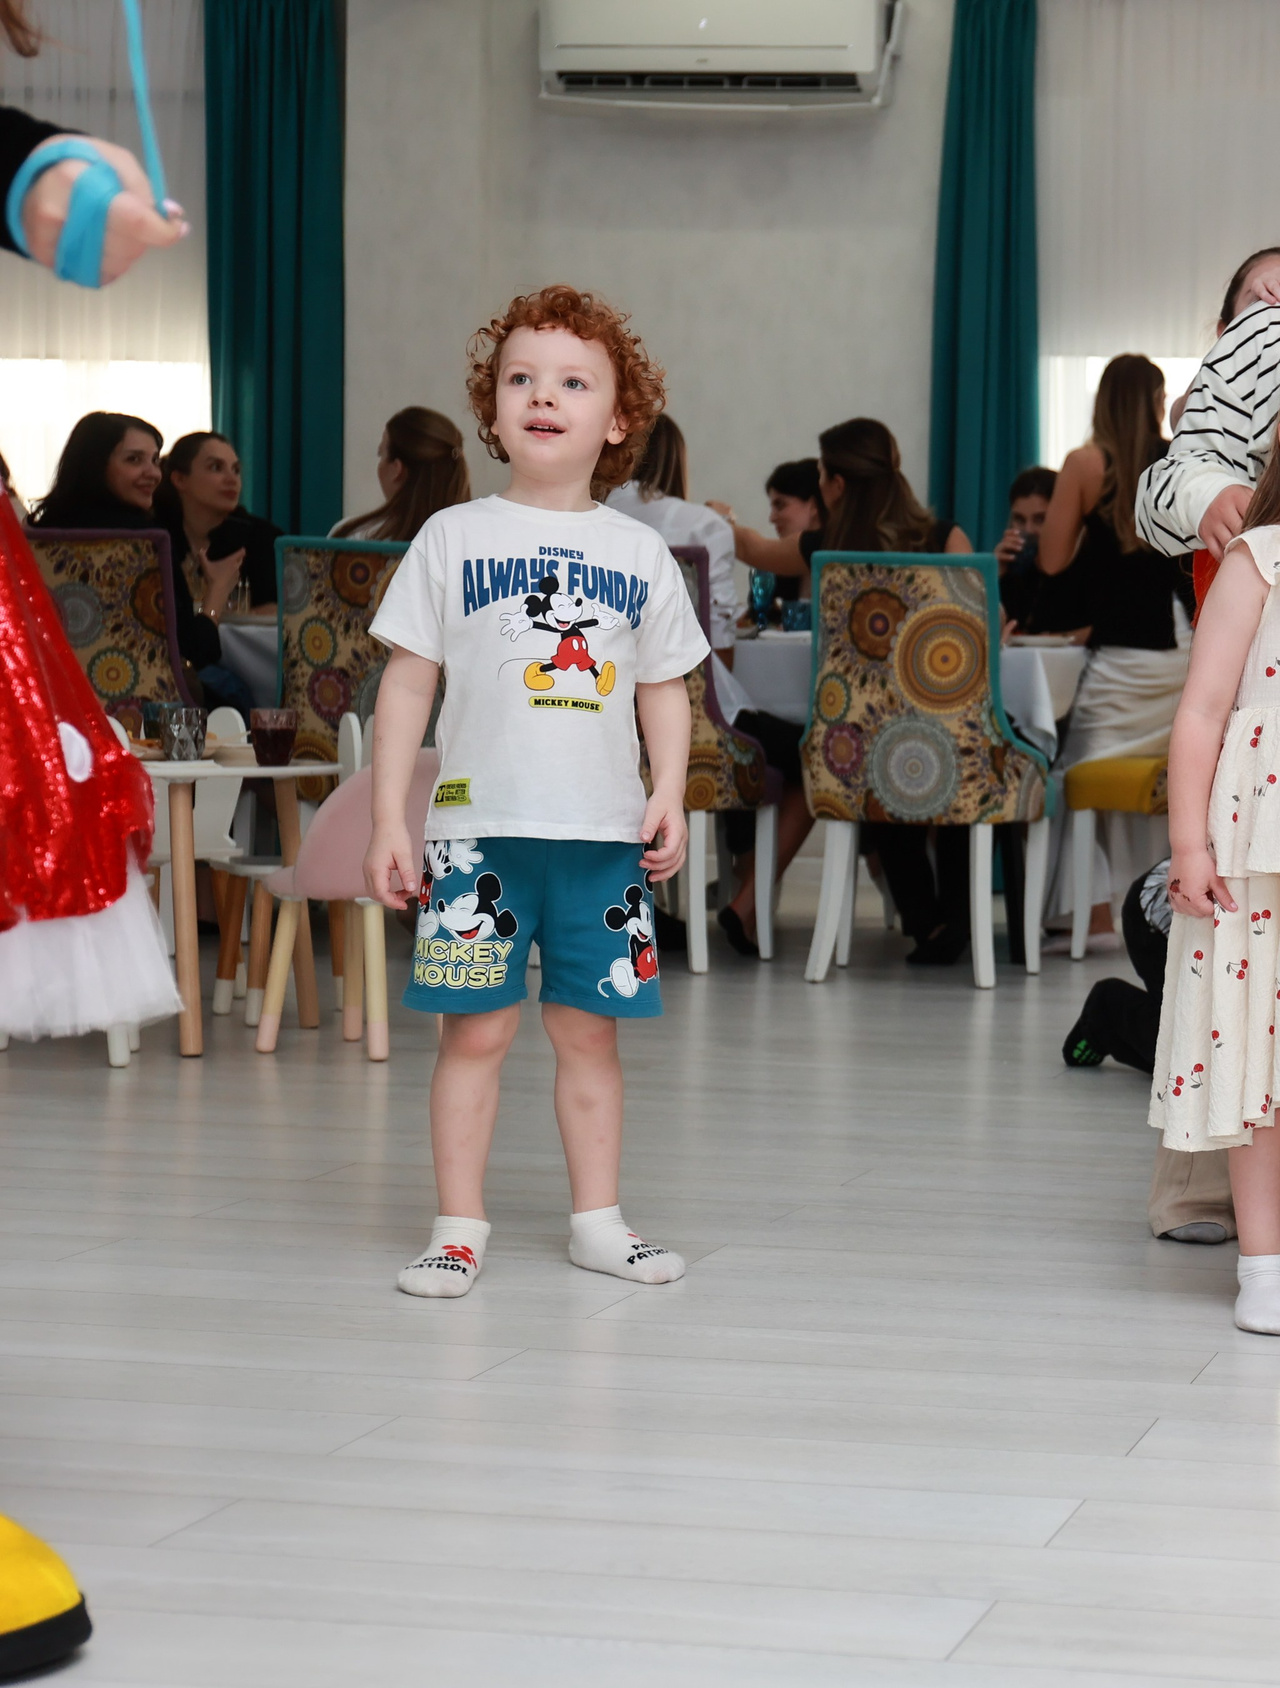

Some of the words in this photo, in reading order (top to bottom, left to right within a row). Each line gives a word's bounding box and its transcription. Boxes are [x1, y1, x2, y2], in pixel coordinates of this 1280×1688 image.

[539, 546, 584, 560] DISNEY
[534, 698, 569, 707] MICKEY
[571, 700, 600, 711] MOUSE
[414, 936, 514, 964] MICKEY
[413, 960, 508, 990] MOUSE
